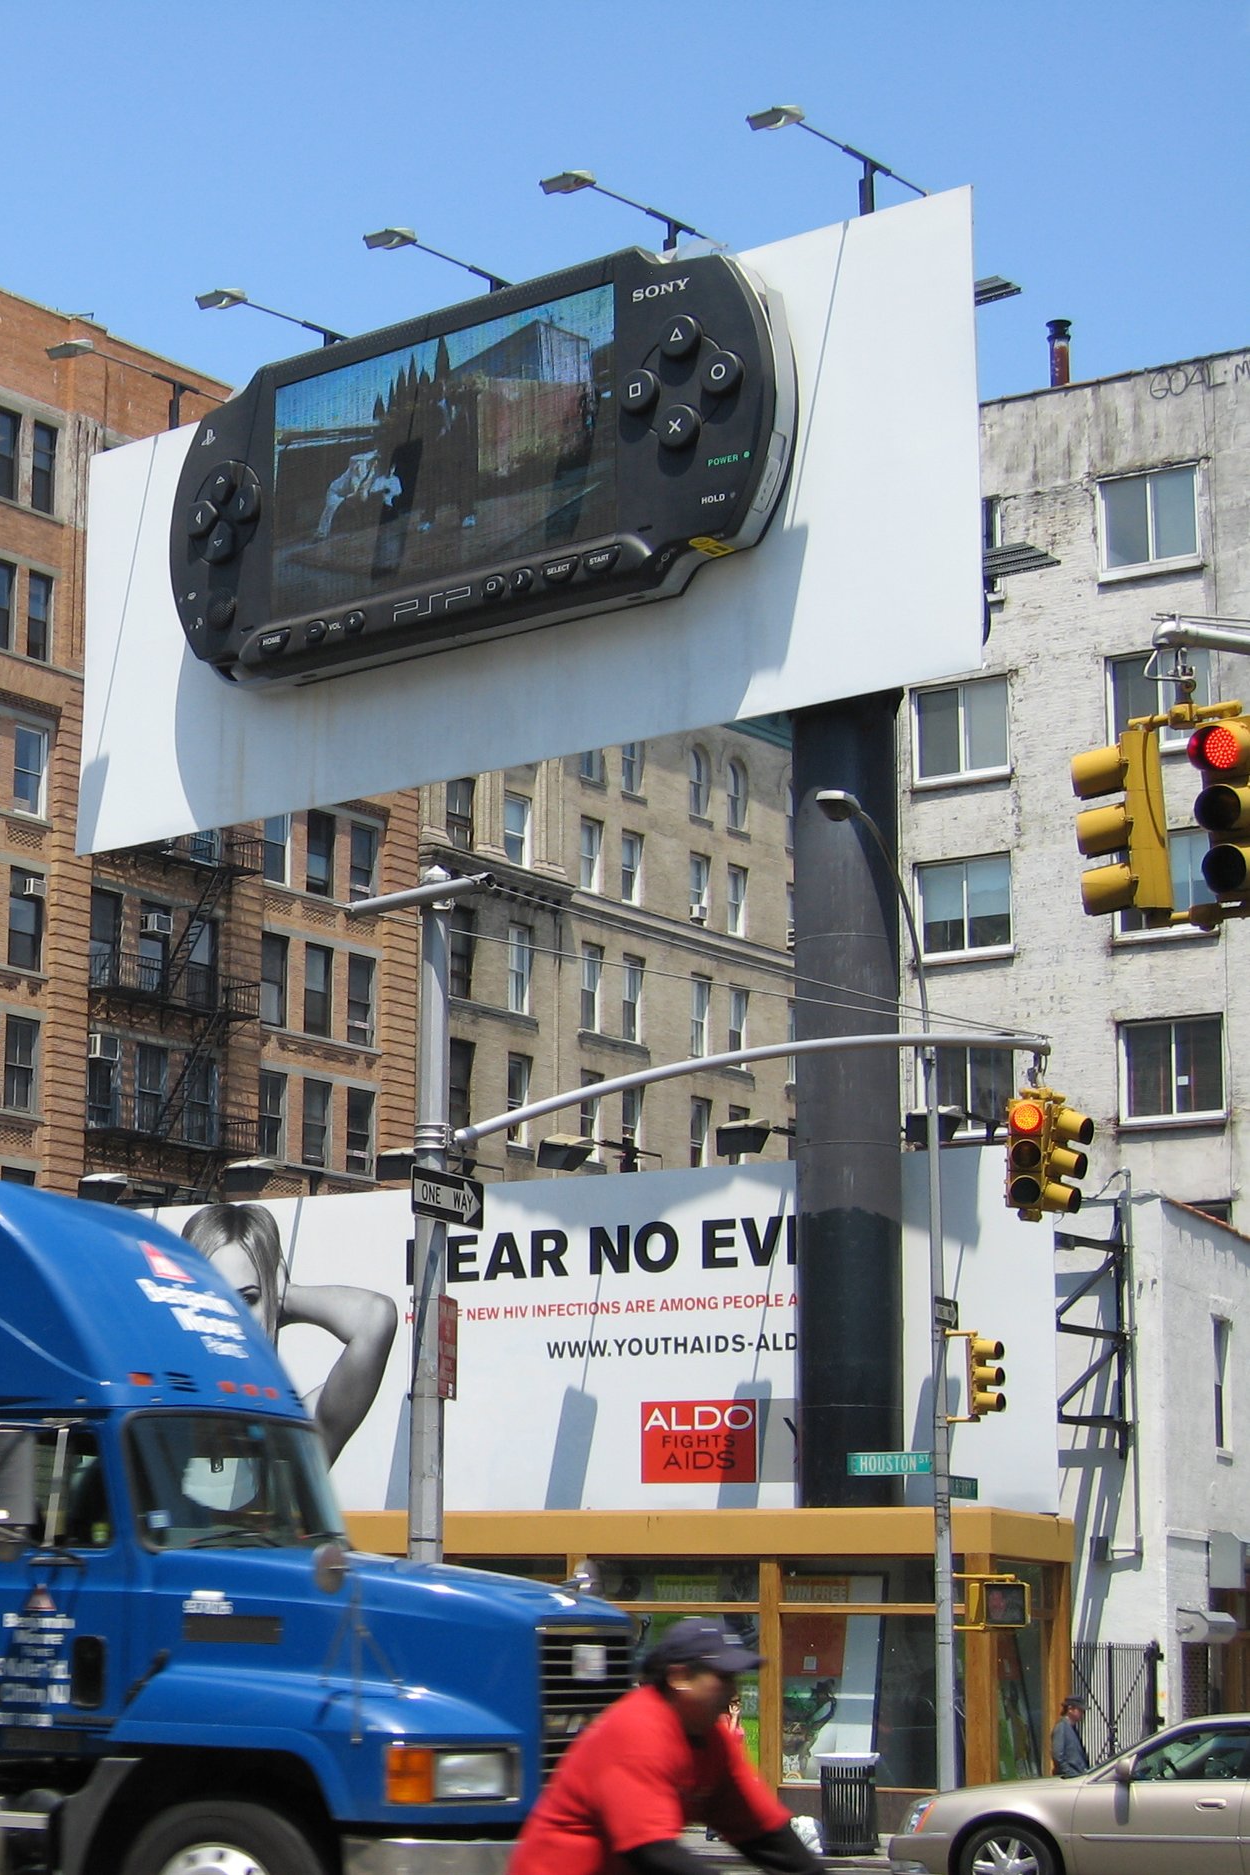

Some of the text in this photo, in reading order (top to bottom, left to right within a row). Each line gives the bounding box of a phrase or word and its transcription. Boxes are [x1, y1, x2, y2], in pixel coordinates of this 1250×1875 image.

[632, 277, 690, 302] SONY
[707, 453, 738, 466] POWER
[701, 493, 725, 504] HOLD
[589, 553, 610, 565] START
[546, 563, 570, 575] SELECT
[394, 586, 471, 622] PSP
[329, 622, 341, 631] VOL
[262, 634, 281, 646] HOME
[421, 1183, 474, 1213] ONE WAY
[406, 1215, 797, 1285] EAR NO EVI
[466, 1306, 500, 1321] NEW
[503, 1305, 528, 1319] HIV
[532, 1301, 620, 1318] INFECTIONS
[625, 1300, 655, 1313] ARE
[659, 1296, 718, 1312] AMONG
[723, 1294, 784, 1309] PEOPLE
[547, 1333, 797, 1358] WWW.YOUTHAIDS-ALD
[644, 1405, 753, 1431] ALDO
[662, 1434, 735, 1448] FIGHTS
[663, 1451, 736, 1470] AIDS
[860, 1455, 916, 1472] HOUSTON
[918, 1454, 929, 1463] ST
[685, 1585, 717, 1600] FREE
[813, 1585, 846, 1600] FREE
